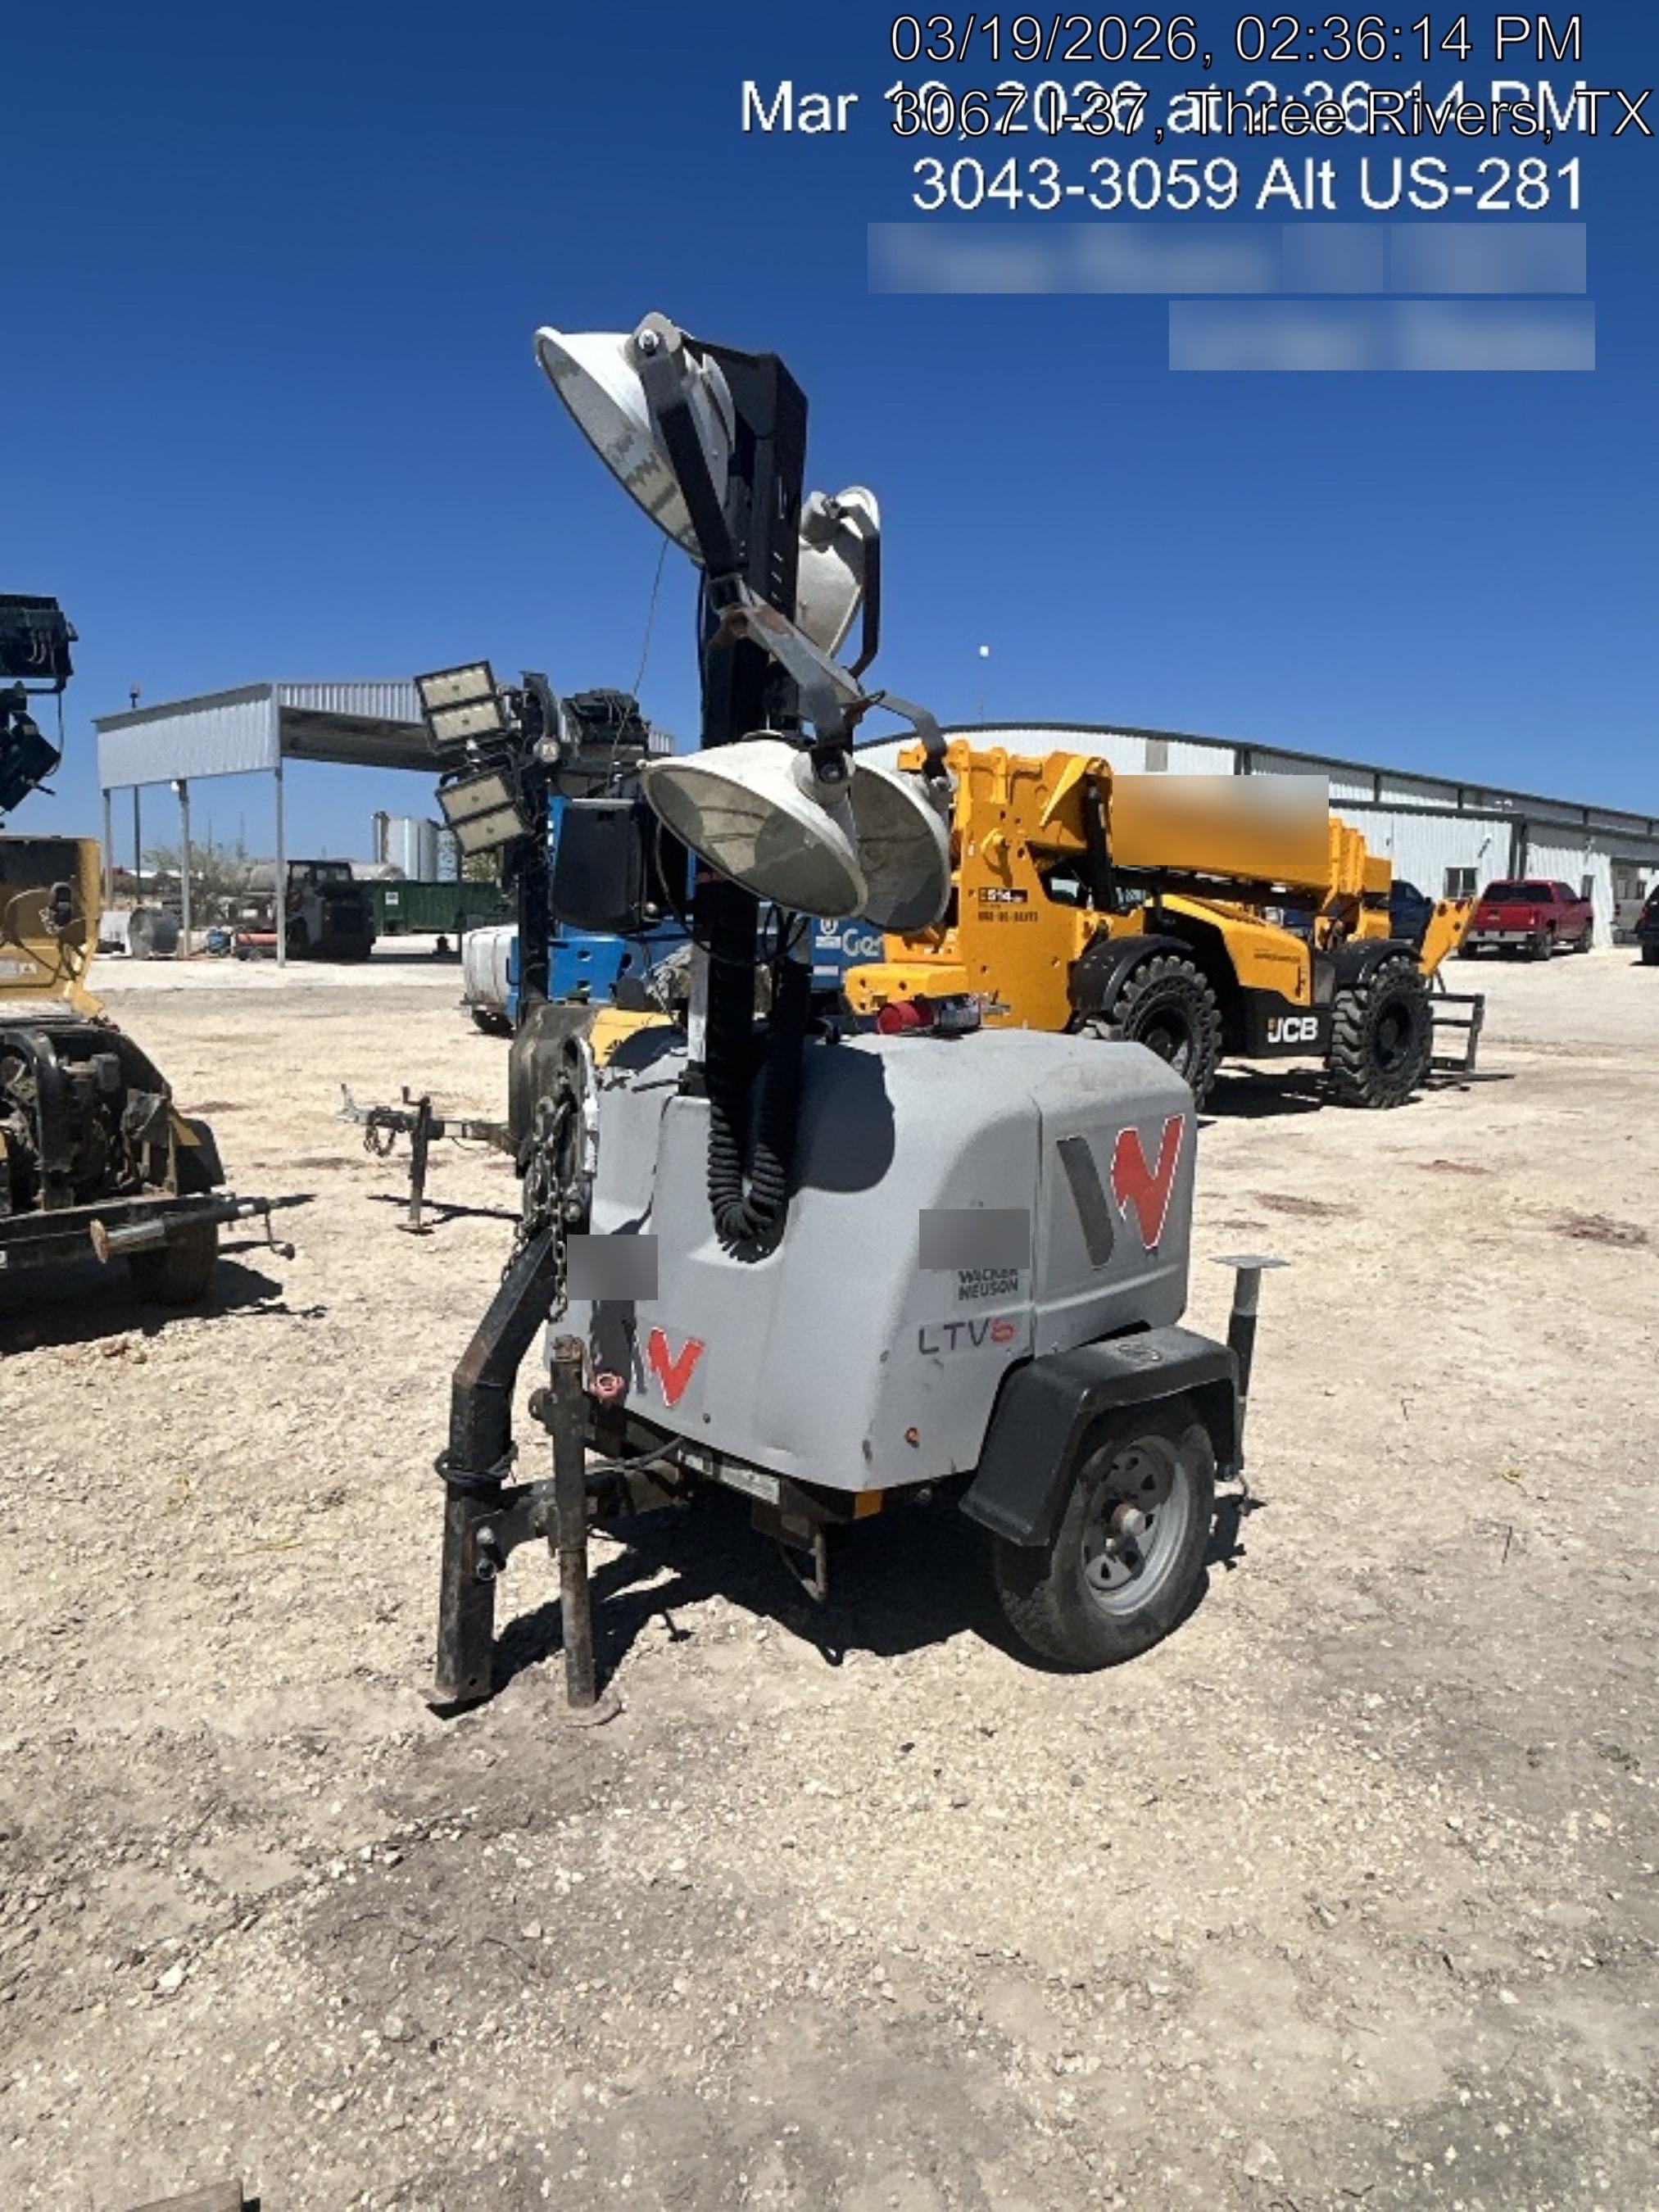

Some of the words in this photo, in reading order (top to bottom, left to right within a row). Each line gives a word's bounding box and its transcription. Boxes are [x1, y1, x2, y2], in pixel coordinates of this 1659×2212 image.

[1267, 1017, 1318, 1043] JCB
[958, 1278, 1018, 1301] NEUSON
[918, 1317, 1015, 1355] LTV6
